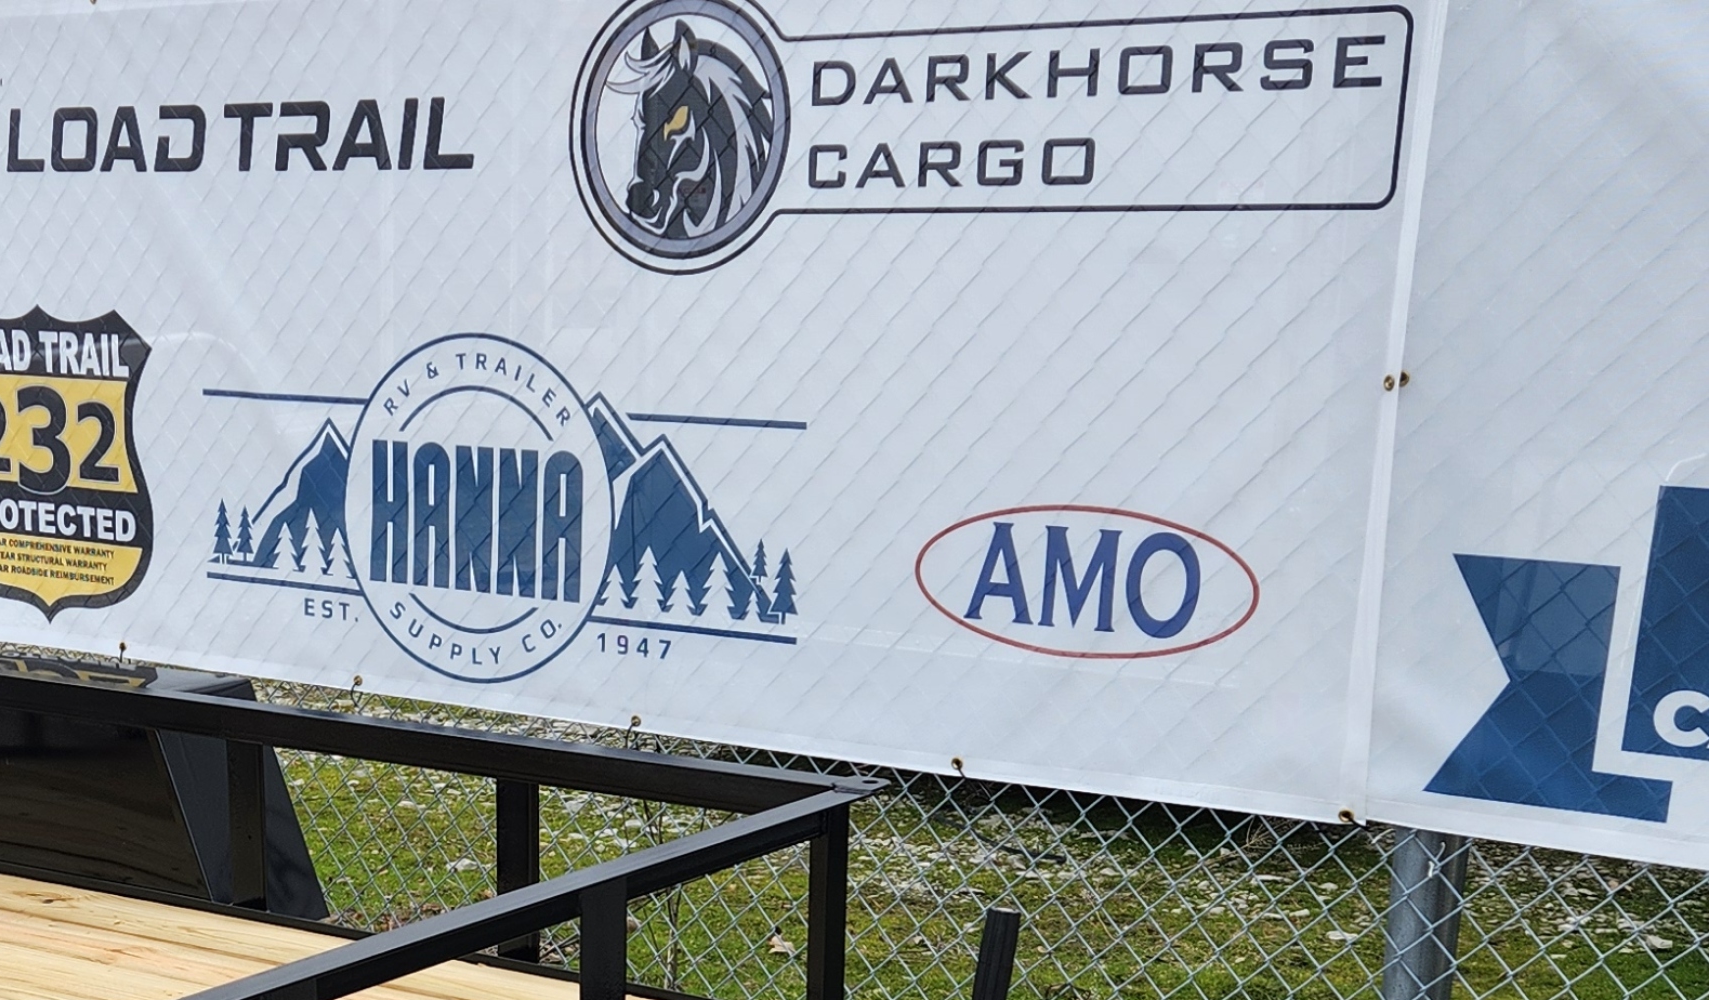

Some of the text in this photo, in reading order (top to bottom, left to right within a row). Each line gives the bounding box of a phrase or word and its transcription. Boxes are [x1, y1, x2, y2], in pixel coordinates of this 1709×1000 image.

[811, 34, 1386, 106] DARKHORSE
[6, 96, 475, 173] LOAD TRAIL
[808, 137, 1096, 189] CARGO
[39, 330, 130, 378] TRAIL
[383, 353, 571, 427] RV & TRAILER
[369, 439, 584, 603] HANNA
[8, 538, 72, 554] COMPREHENSIVE
[73, 546, 115, 559] WARRANTY
[17, 552, 64, 567] STRUCTURAL
[65, 558, 108, 571] WARRANTY
[11, 565, 49, 578] ROADSIDE
[50, 570, 115, 585] REIMBURSEMENT
[963, 522, 1201, 639] AMO
[304, 598, 359, 622] EST.
[390, 601, 563, 665] SUPPLY CO.
[596, 632, 672, 660] 1947
